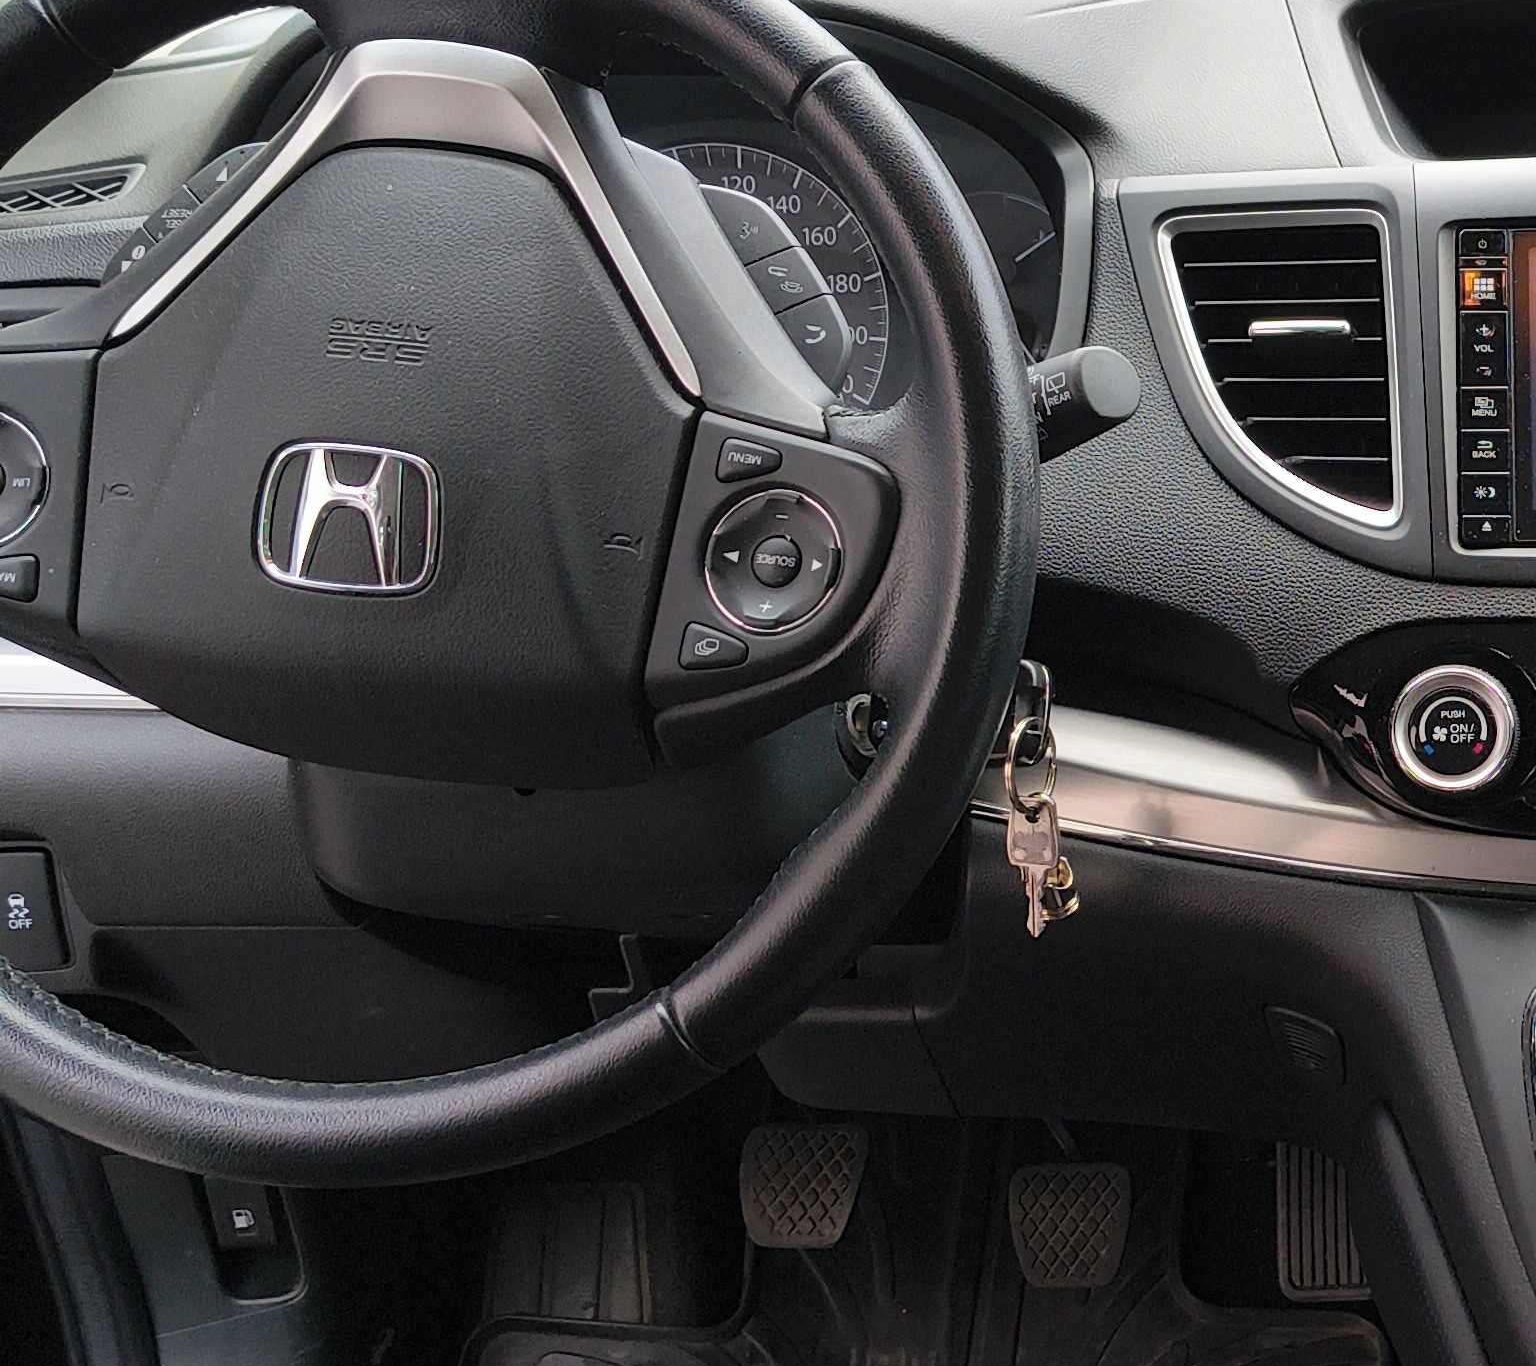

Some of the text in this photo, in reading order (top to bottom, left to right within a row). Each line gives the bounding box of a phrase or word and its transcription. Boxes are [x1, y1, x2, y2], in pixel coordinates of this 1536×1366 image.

[767, 195, 801, 214] 140
[802, 226, 837, 246] 160
[826, 274, 861, 293] 180
[1470, 292, 1497, 300] HOME
[1473, 344, 1495, 353] VOL
[1048, 391, 1072, 408] REAR
[1471, 409, 1498, 417] MENU
[728, 451, 762, 465] MENU
[1471, 450, 1497, 459] BACK
[12, 477, 31, 487] LIM
[755, 553, 796, 568] SOURCE
[1440, 709, 1466, 719] PUSH
[1450, 733, 1475, 744] OFF
[8, 918, 33, 930] OFF
